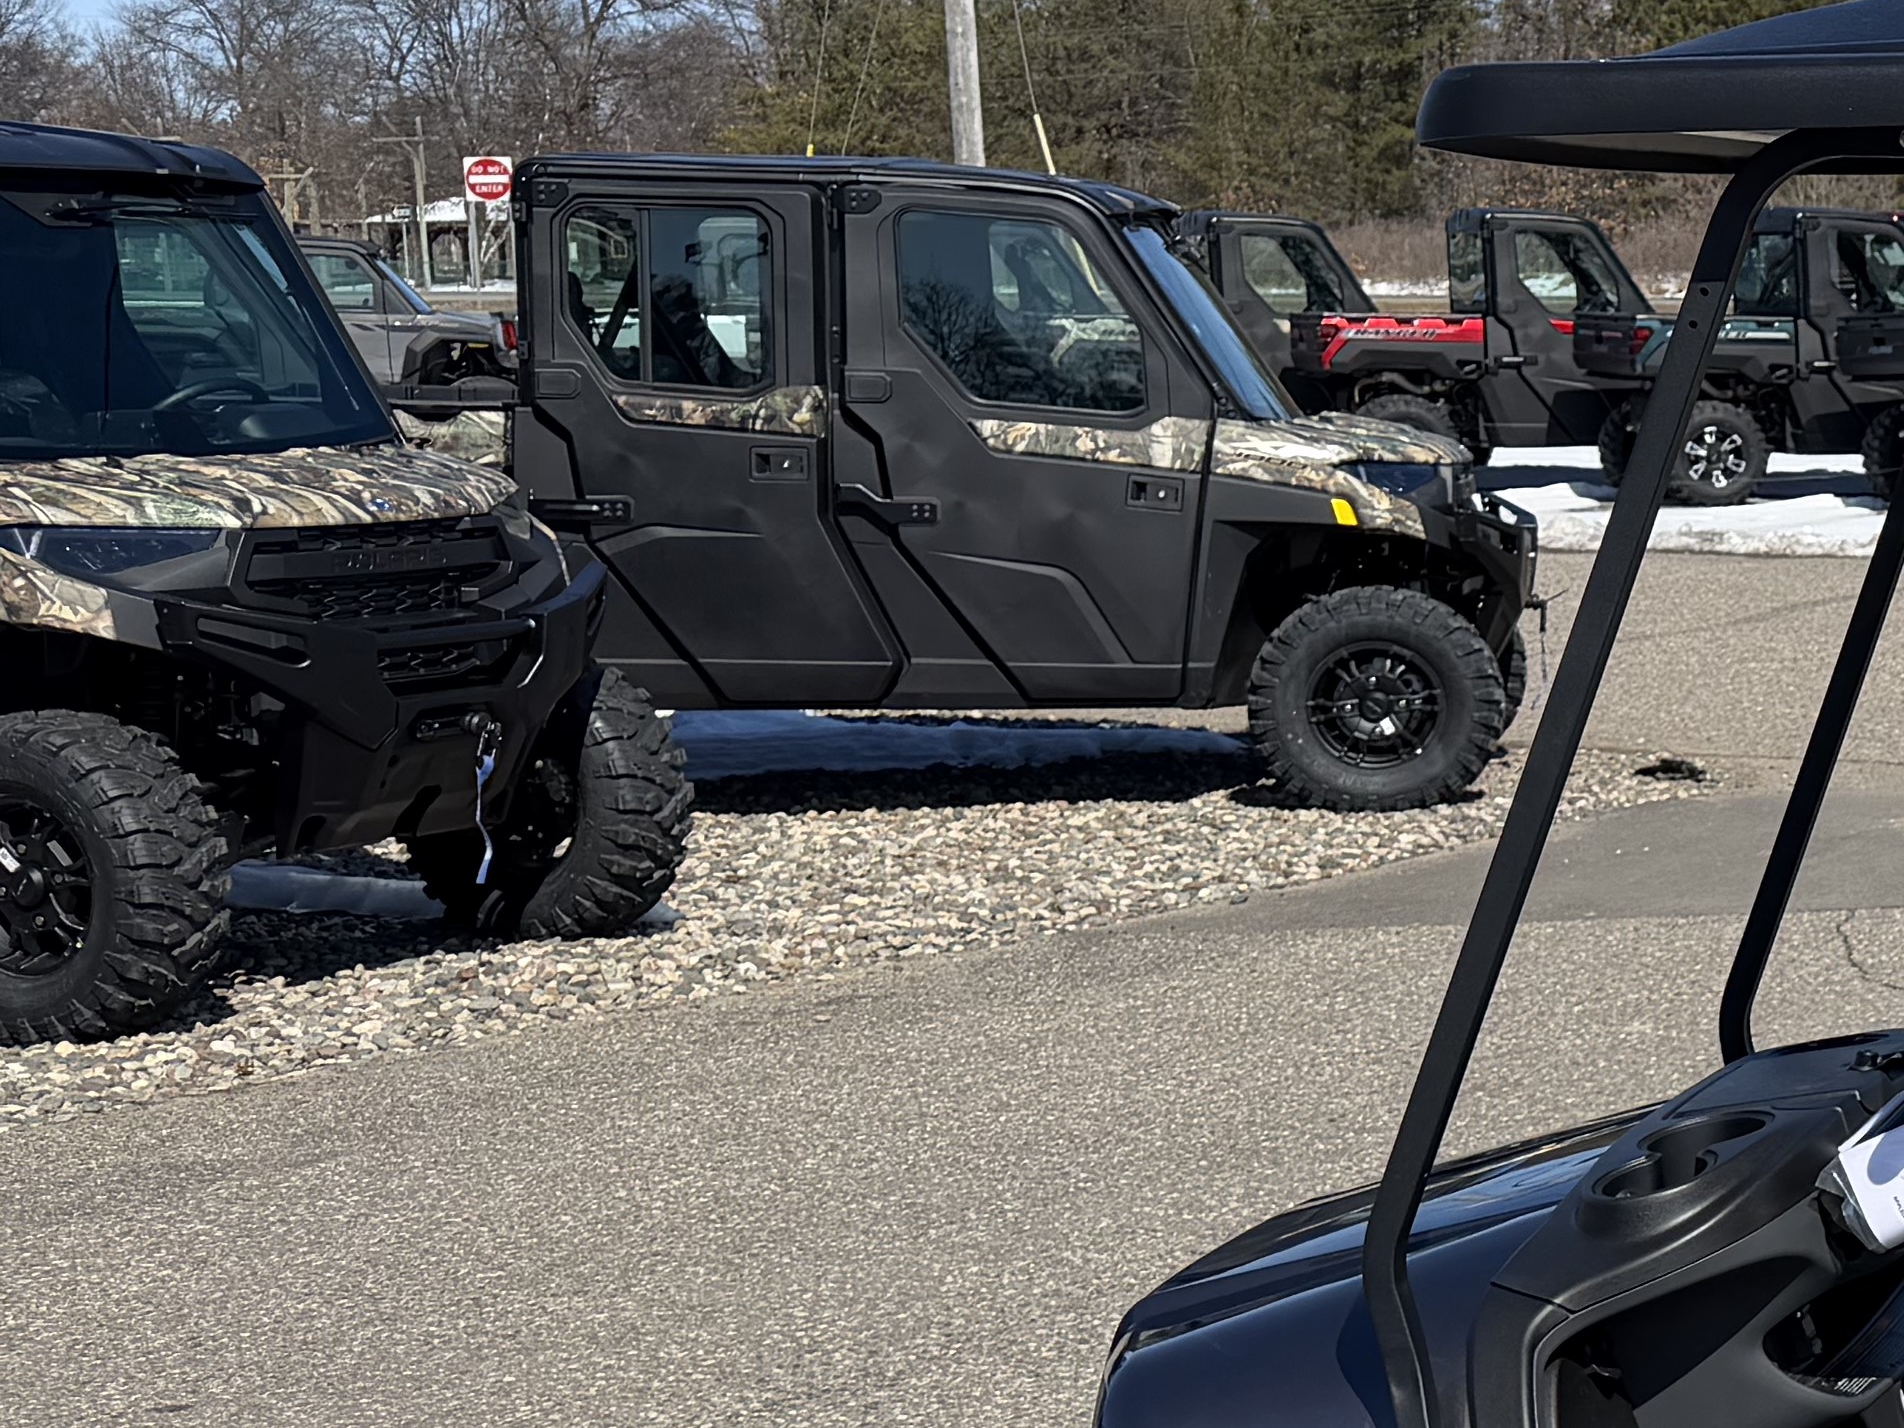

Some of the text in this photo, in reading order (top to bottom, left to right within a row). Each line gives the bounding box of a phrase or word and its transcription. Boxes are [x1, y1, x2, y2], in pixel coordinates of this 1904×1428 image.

[470, 164, 505, 174] DO NOT
[475, 183, 504, 194] ENTER
